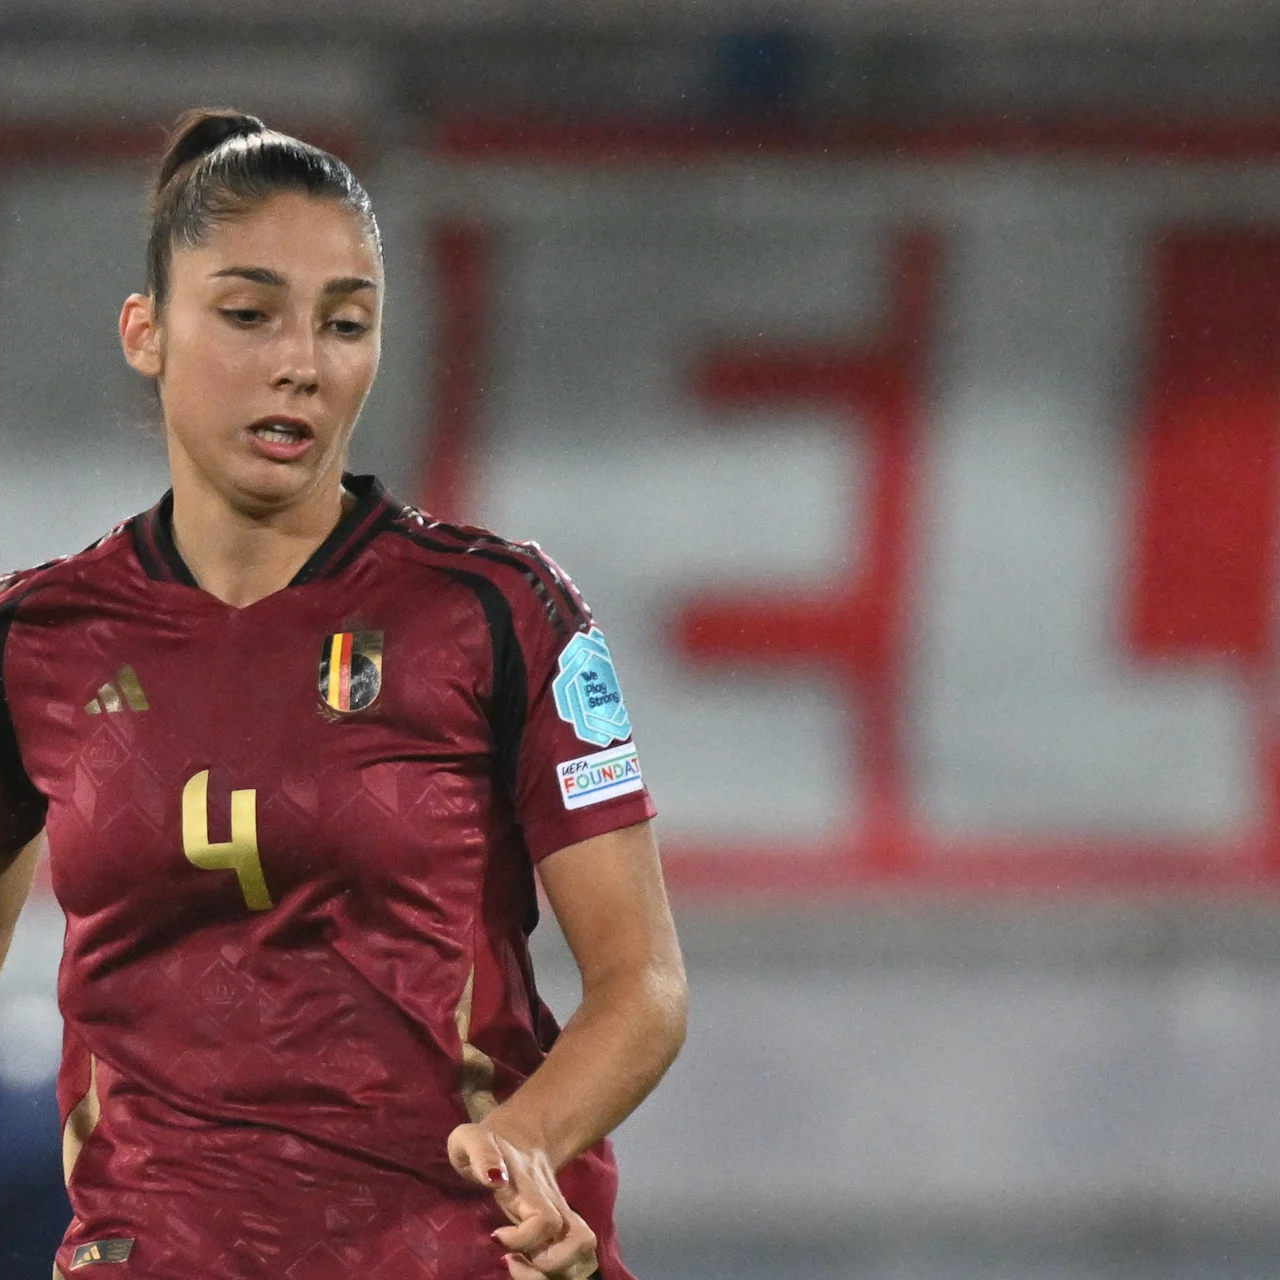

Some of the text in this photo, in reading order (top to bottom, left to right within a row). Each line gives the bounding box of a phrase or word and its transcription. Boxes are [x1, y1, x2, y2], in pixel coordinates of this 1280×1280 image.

[580, 671, 598, 682] We
[585, 682, 607, 696] Play
[588, 692, 620, 708] Strong
[562, 761, 588, 776] UEFA
[182, 769, 273, 911] 4
